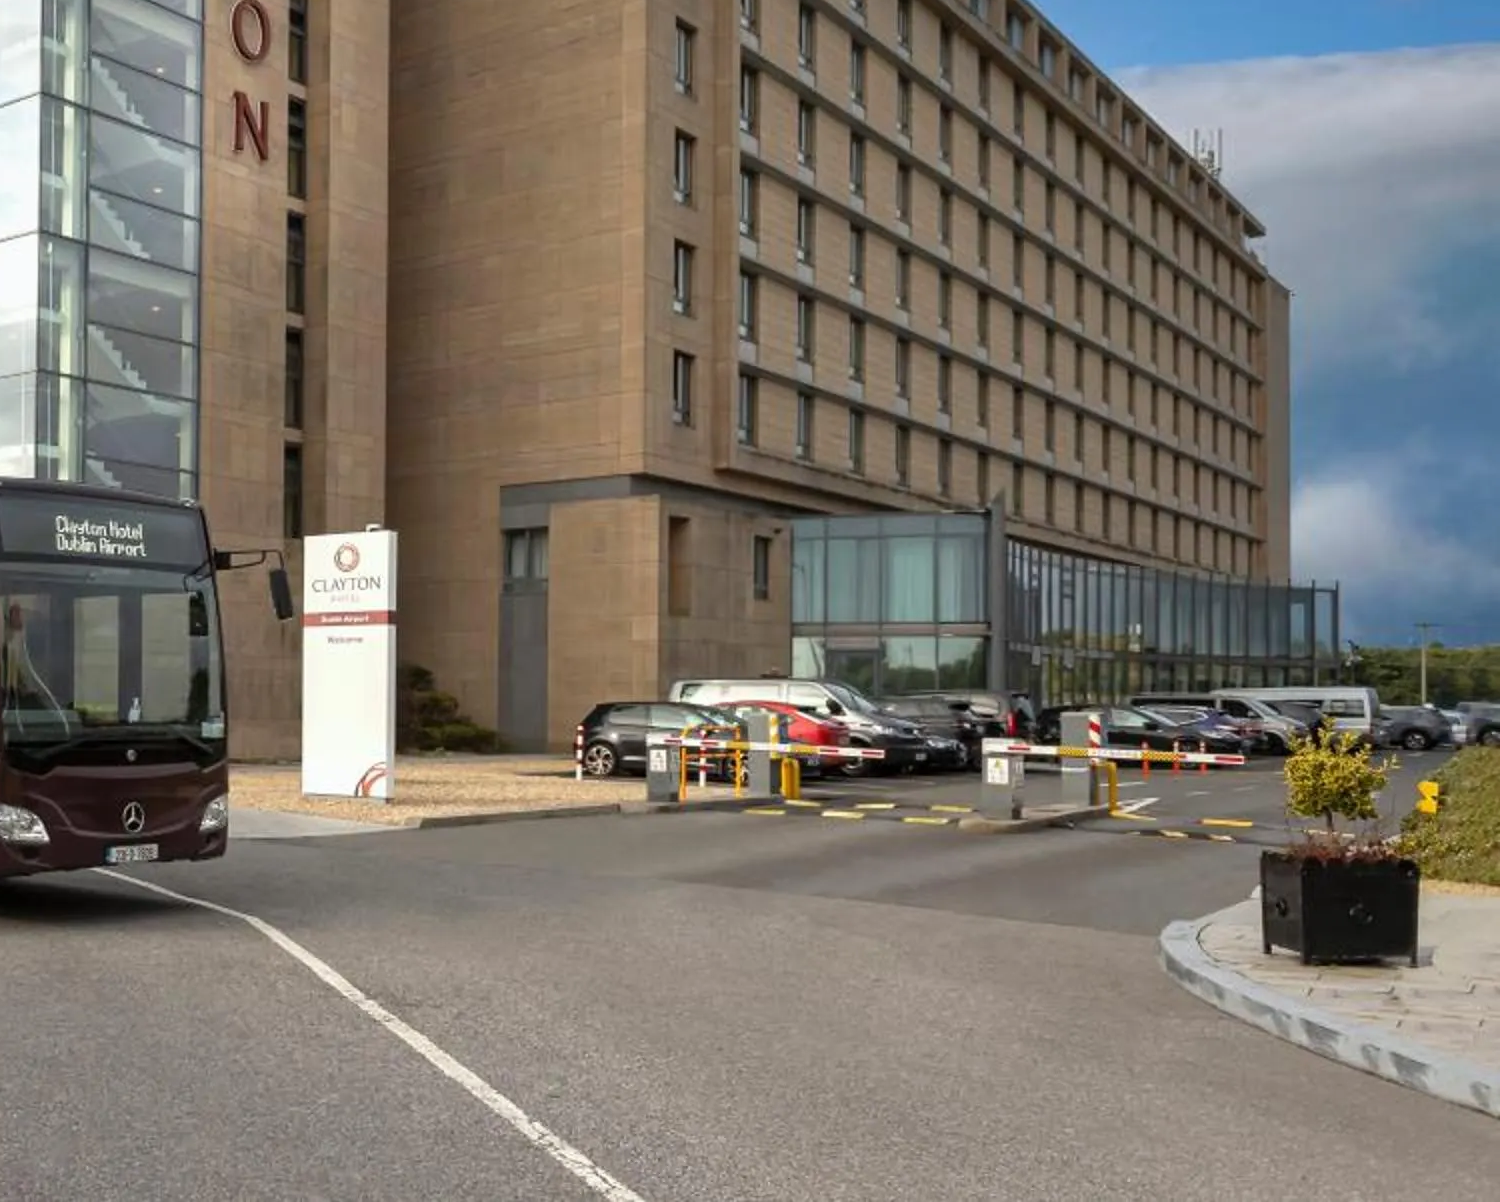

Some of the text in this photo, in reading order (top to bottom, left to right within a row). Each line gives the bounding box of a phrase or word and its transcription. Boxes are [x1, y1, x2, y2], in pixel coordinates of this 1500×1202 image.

[109, 519, 143, 540] Hotel
[56, 533, 147, 557] Dublin Airport
[311, 575, 381, 593] CLAYTON
